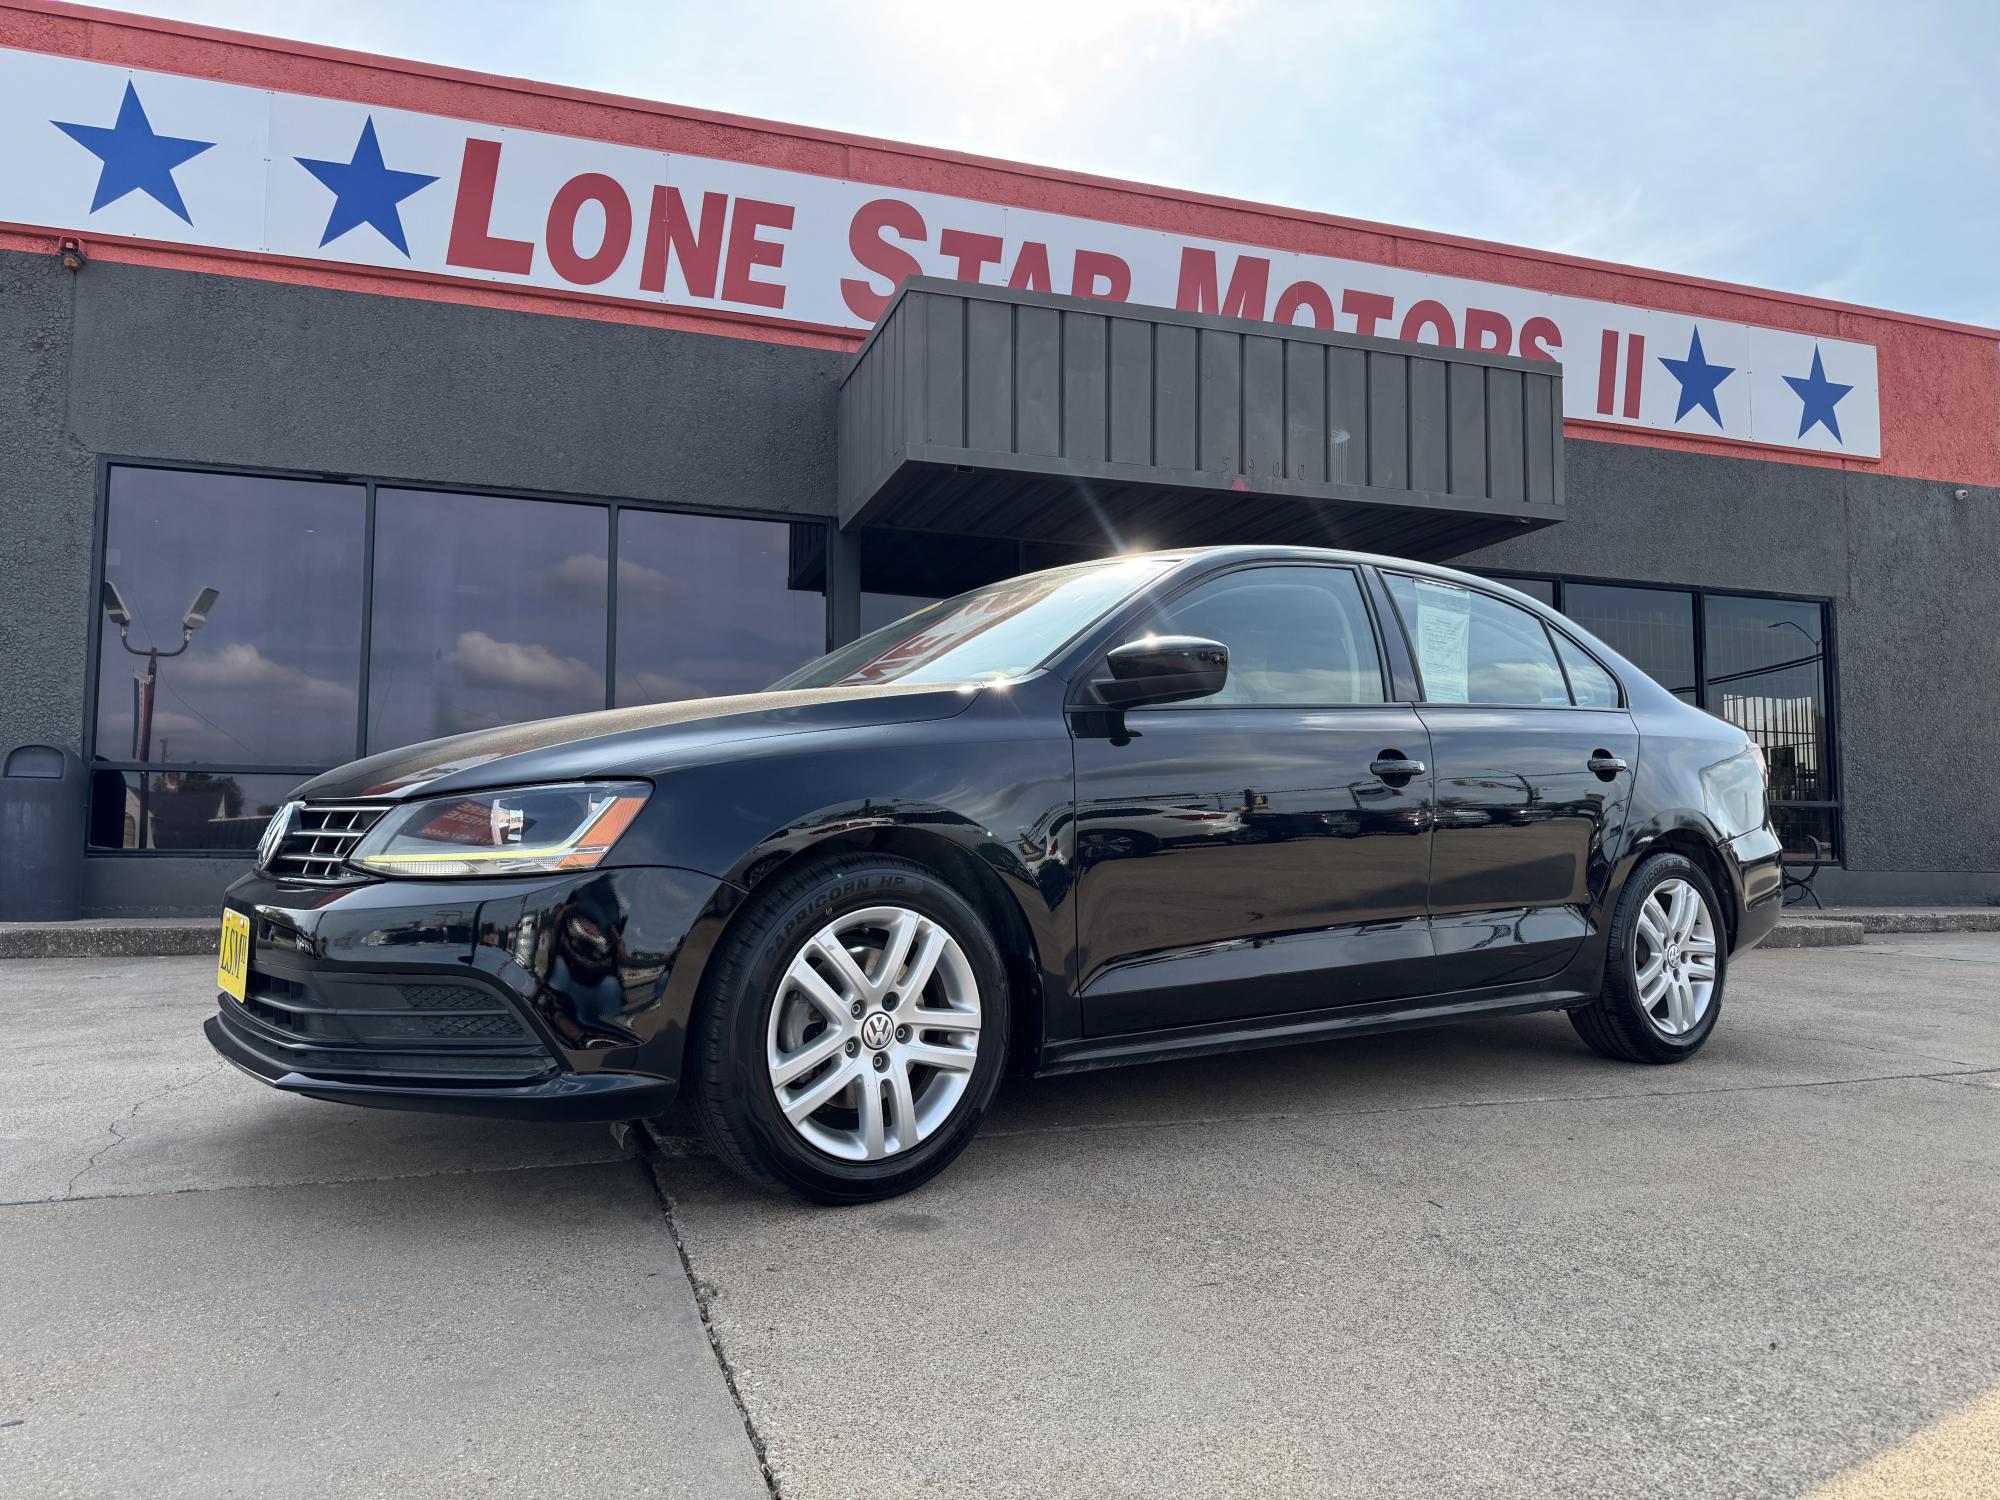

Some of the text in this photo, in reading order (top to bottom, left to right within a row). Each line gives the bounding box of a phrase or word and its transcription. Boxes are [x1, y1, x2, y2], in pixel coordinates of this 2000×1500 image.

[446, 138, 1645, 419] LONE STAR MOTORS II
